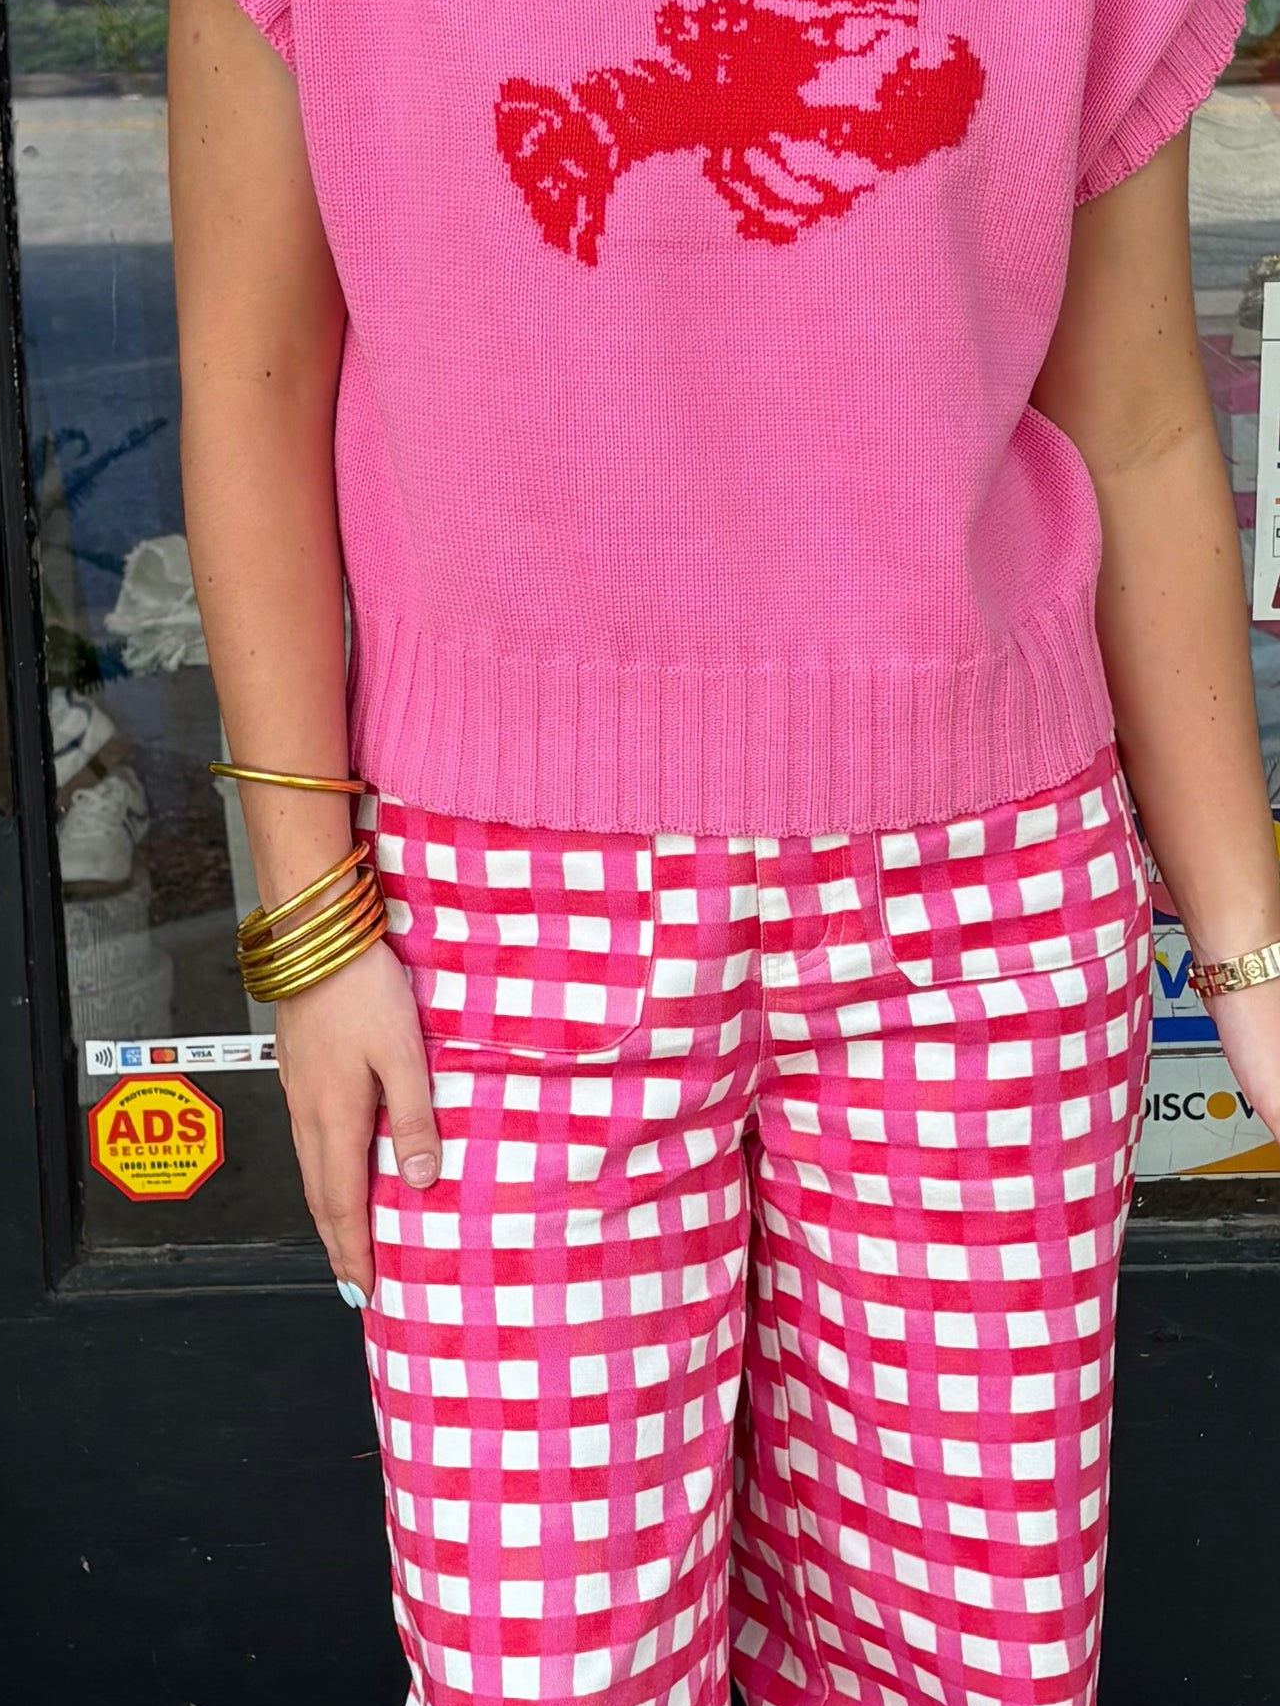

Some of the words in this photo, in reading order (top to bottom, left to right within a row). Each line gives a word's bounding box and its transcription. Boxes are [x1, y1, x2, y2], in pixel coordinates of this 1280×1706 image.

[191, 1050, 213, 1058] VISA
[119, 1087, 176, 1106] PROTECTION
[177, 1094, 190, 1104] BY
[107, 1107, 206, 1144] ADS
[109, 1144, 207, 1157] SECURITY
